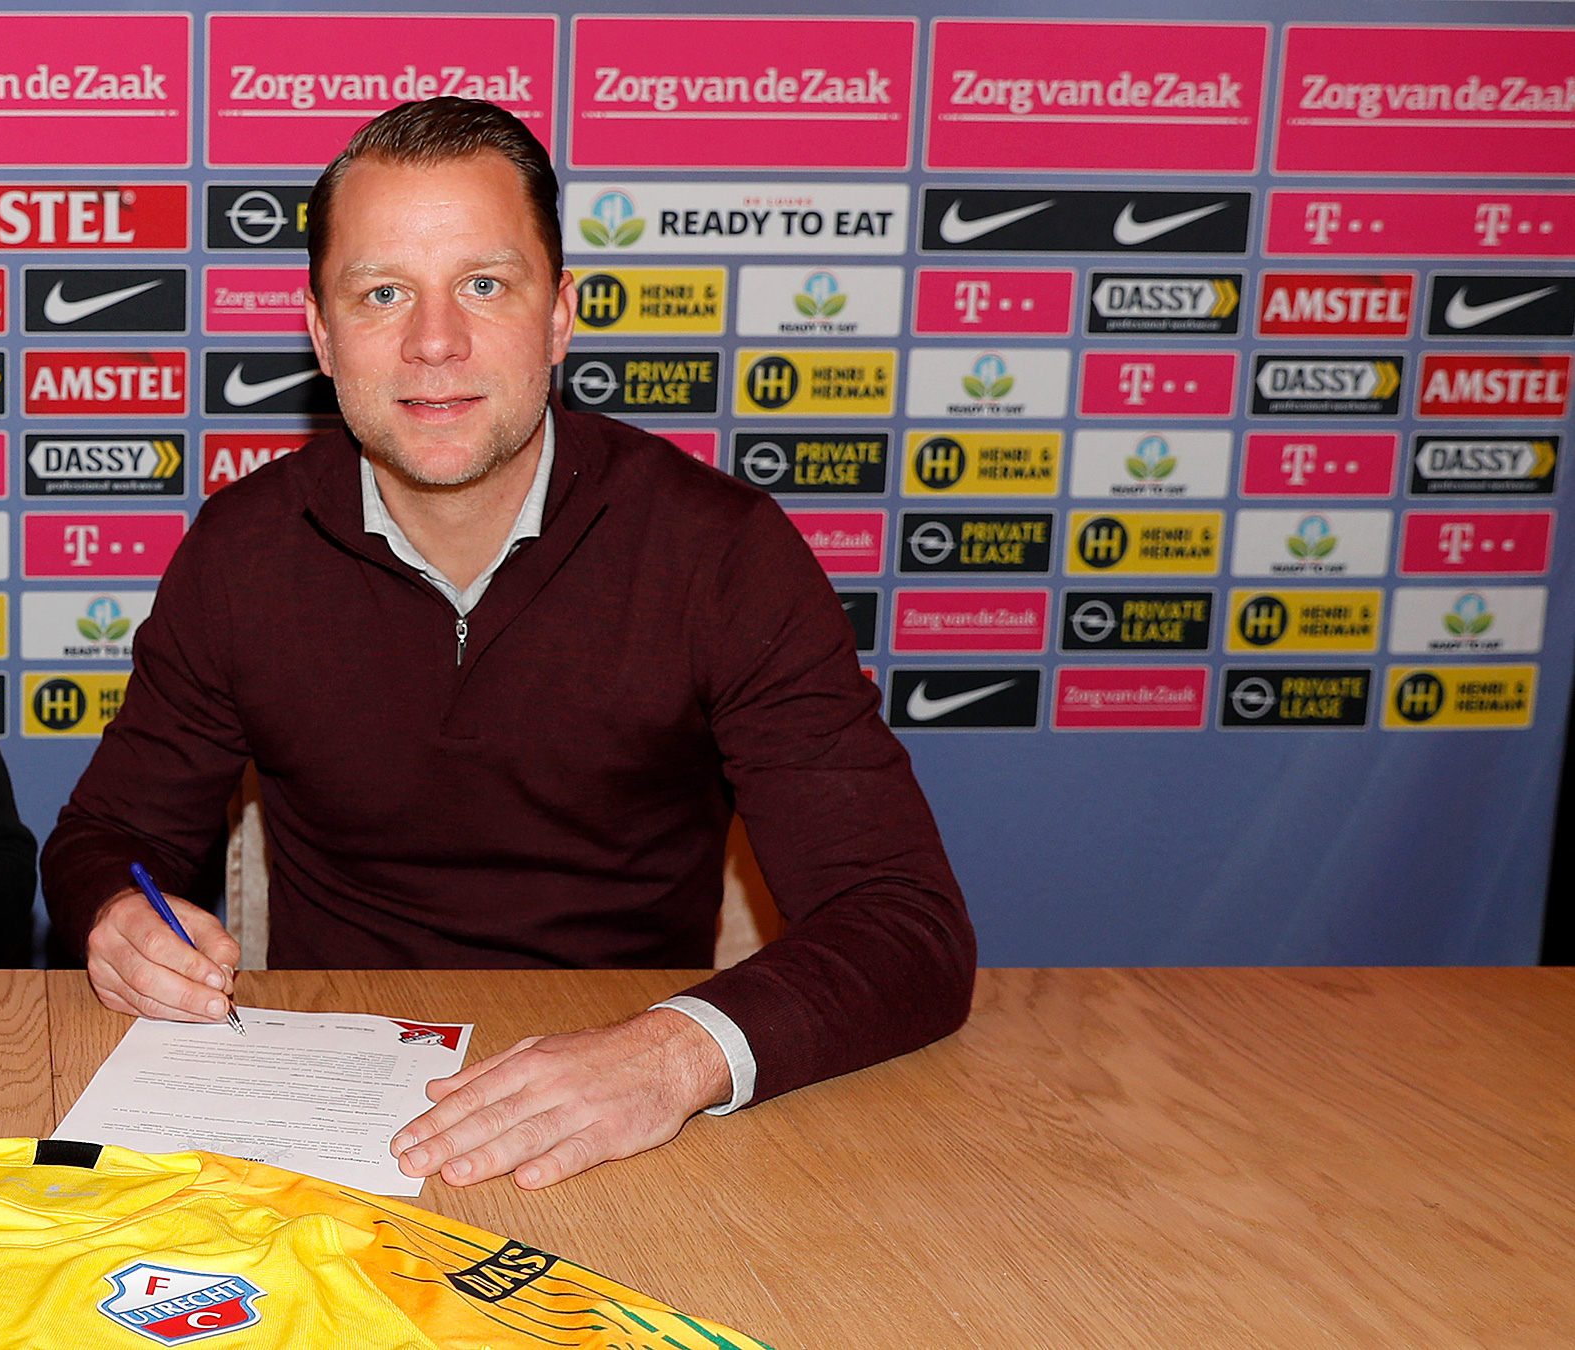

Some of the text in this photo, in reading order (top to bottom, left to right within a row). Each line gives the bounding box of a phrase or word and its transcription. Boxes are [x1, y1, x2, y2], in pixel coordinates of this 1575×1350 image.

[24, 65, 72, 100] de
[74, 64, 168, 99] Zaak
[229, 66, 532, 109] Zorg van de Zaak
[593, 67, 893, 110] Zorg van de Zaak
[950, 70, 1245, 113] Zorg van de Zaak
[1299, 74, 1383, 118] Zorg
[1385, 83, 1453, 111] van
[1453, 75, 1499, 112] de
[660, 210, 893, 237] READY TO EAT
[215, 288, 290, 310] Zorg van
[1107, 285, 1204, 311] DASSY
[1263, 288, 1409, 322] AMSTEL
[29, 366, 182, 400] AMSTEL
[625, 361, 712, 382] PRIVATE
[1270, 367, 1366, 393] DASSY
[624, 383, 690, 404] LEASE
[1424, 370, 1564, 402] AMSTEL
[44, 446, 144, 473] DASSY
[795, 442, 881, 462] PRIVATE
[1429, 447, 1523, 472] DASSY
[794, 464, 860, 485] LEASE
[961, 522, 1046, 542] PRIVATE
[960, 543, 1024, 564] LEASE
[1123, 600, 1206, 620] PRIVATE
[1121, 622, 1185, 642] LEASE
[1282, 677, 1364, 697] PRIVATE
[1280, 698, 1343, 718] LEASE
[145, 1275, 171, 1296] F
[119, 1279, 245, 1325] UTRECHT
[187, 1311, 222, 1329] C
